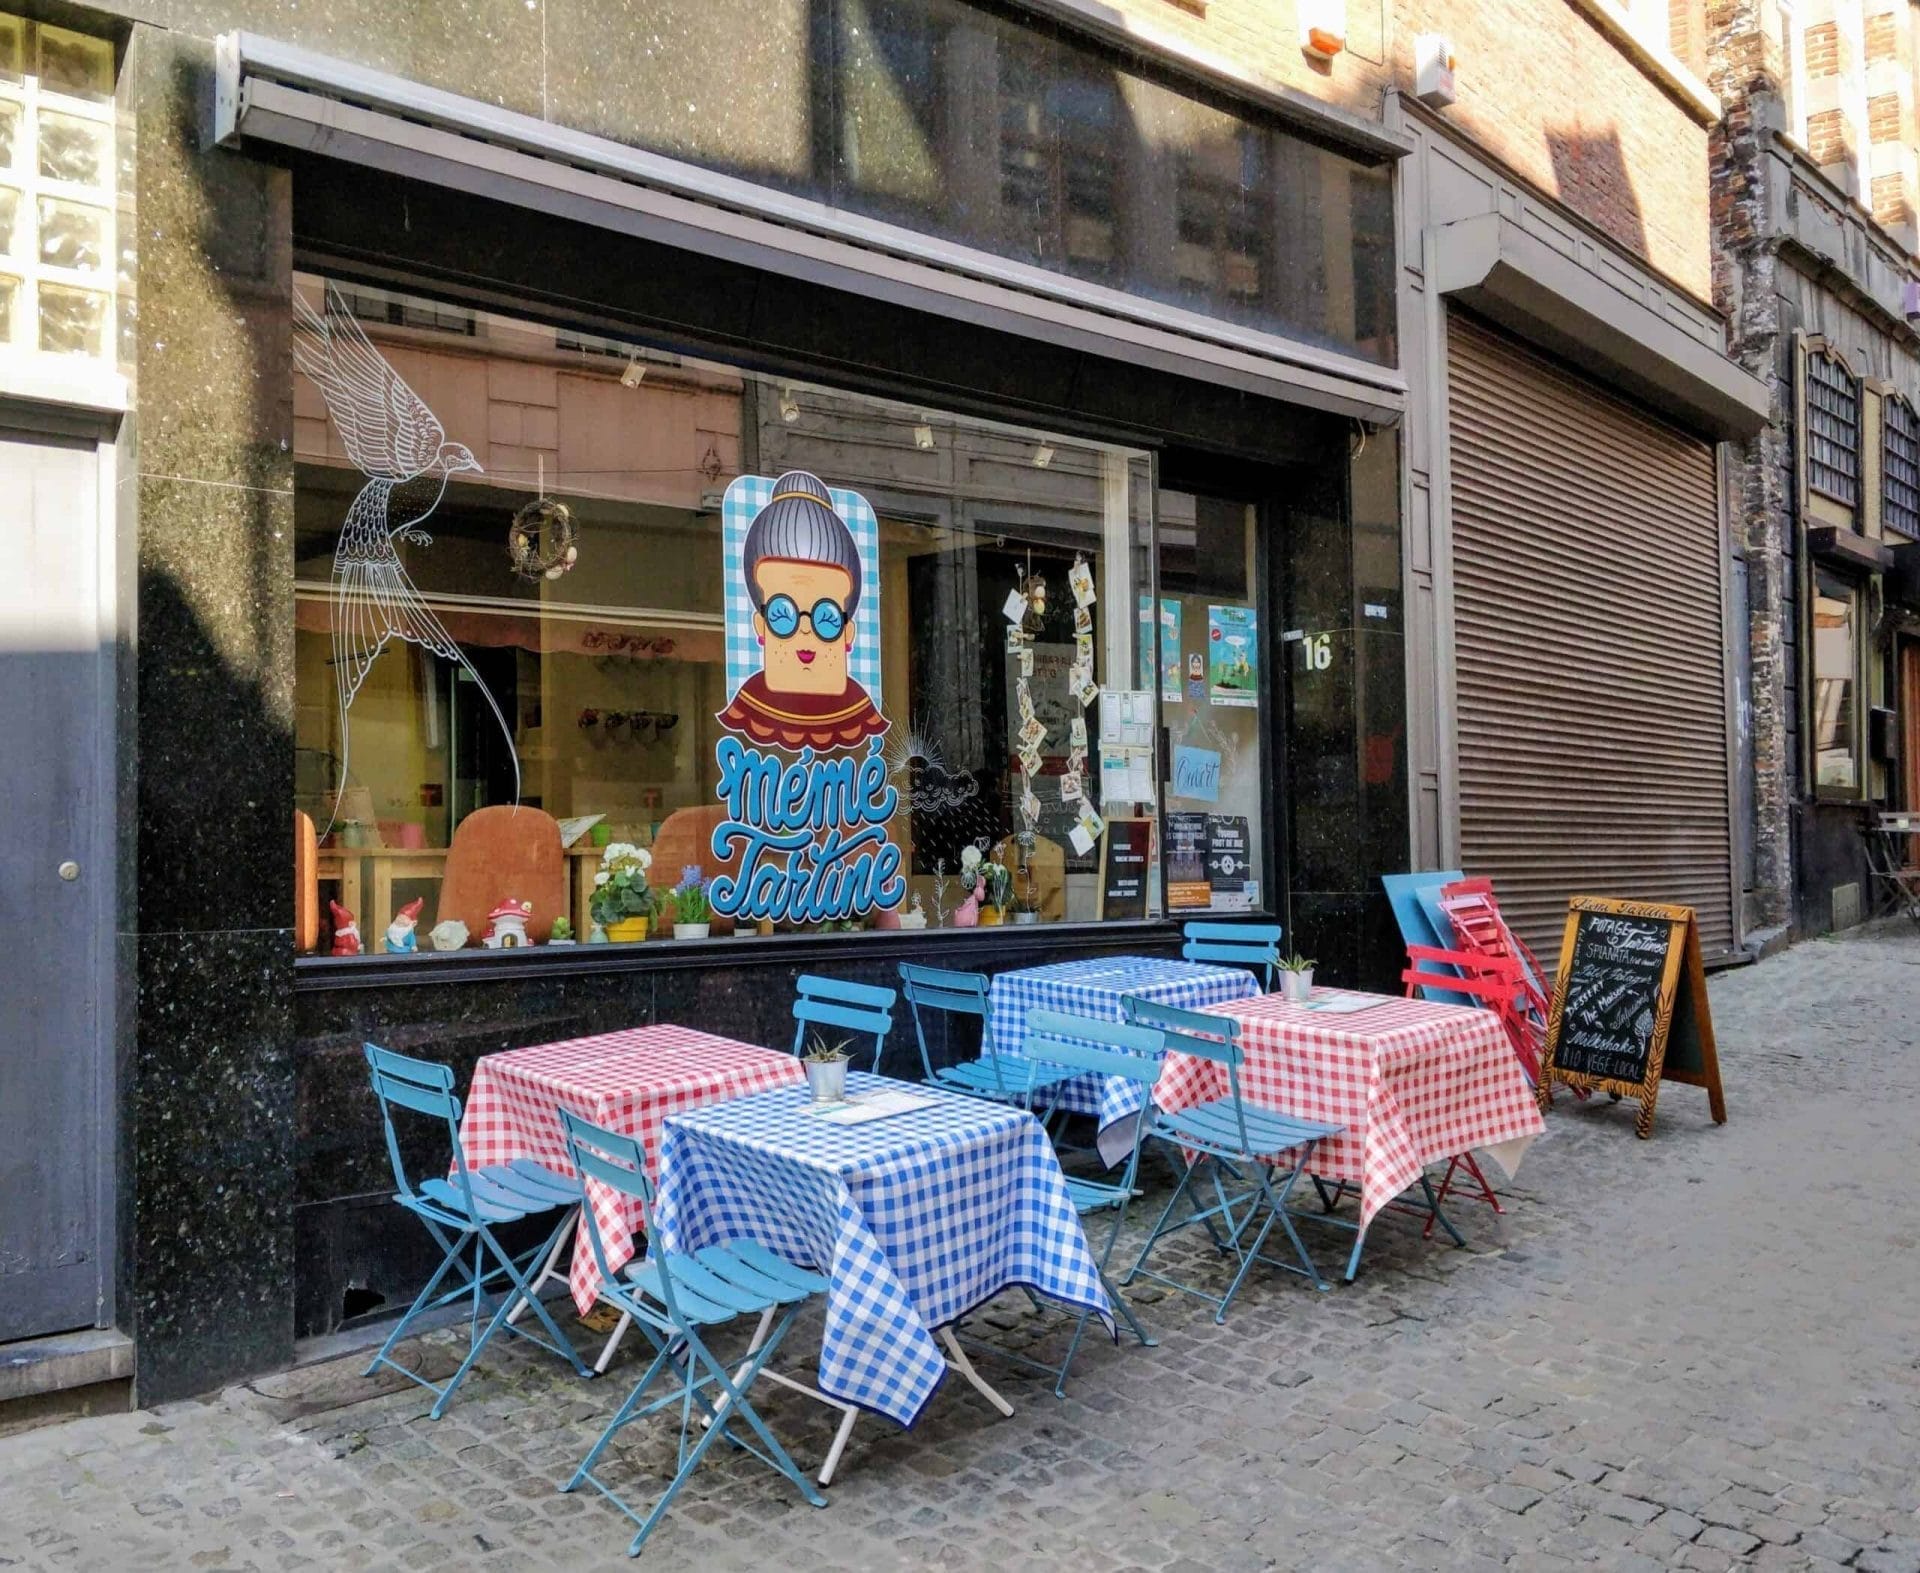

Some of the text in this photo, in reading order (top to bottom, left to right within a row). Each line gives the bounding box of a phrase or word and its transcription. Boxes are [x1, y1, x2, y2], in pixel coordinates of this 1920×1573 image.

[1303, 633, 1333, 671] 16
[709, 820, 907, 924] Tartine
[1589, 916, 1633, 936] POTAGE
[1566, 1030, 1636, 1054] Milkshake
